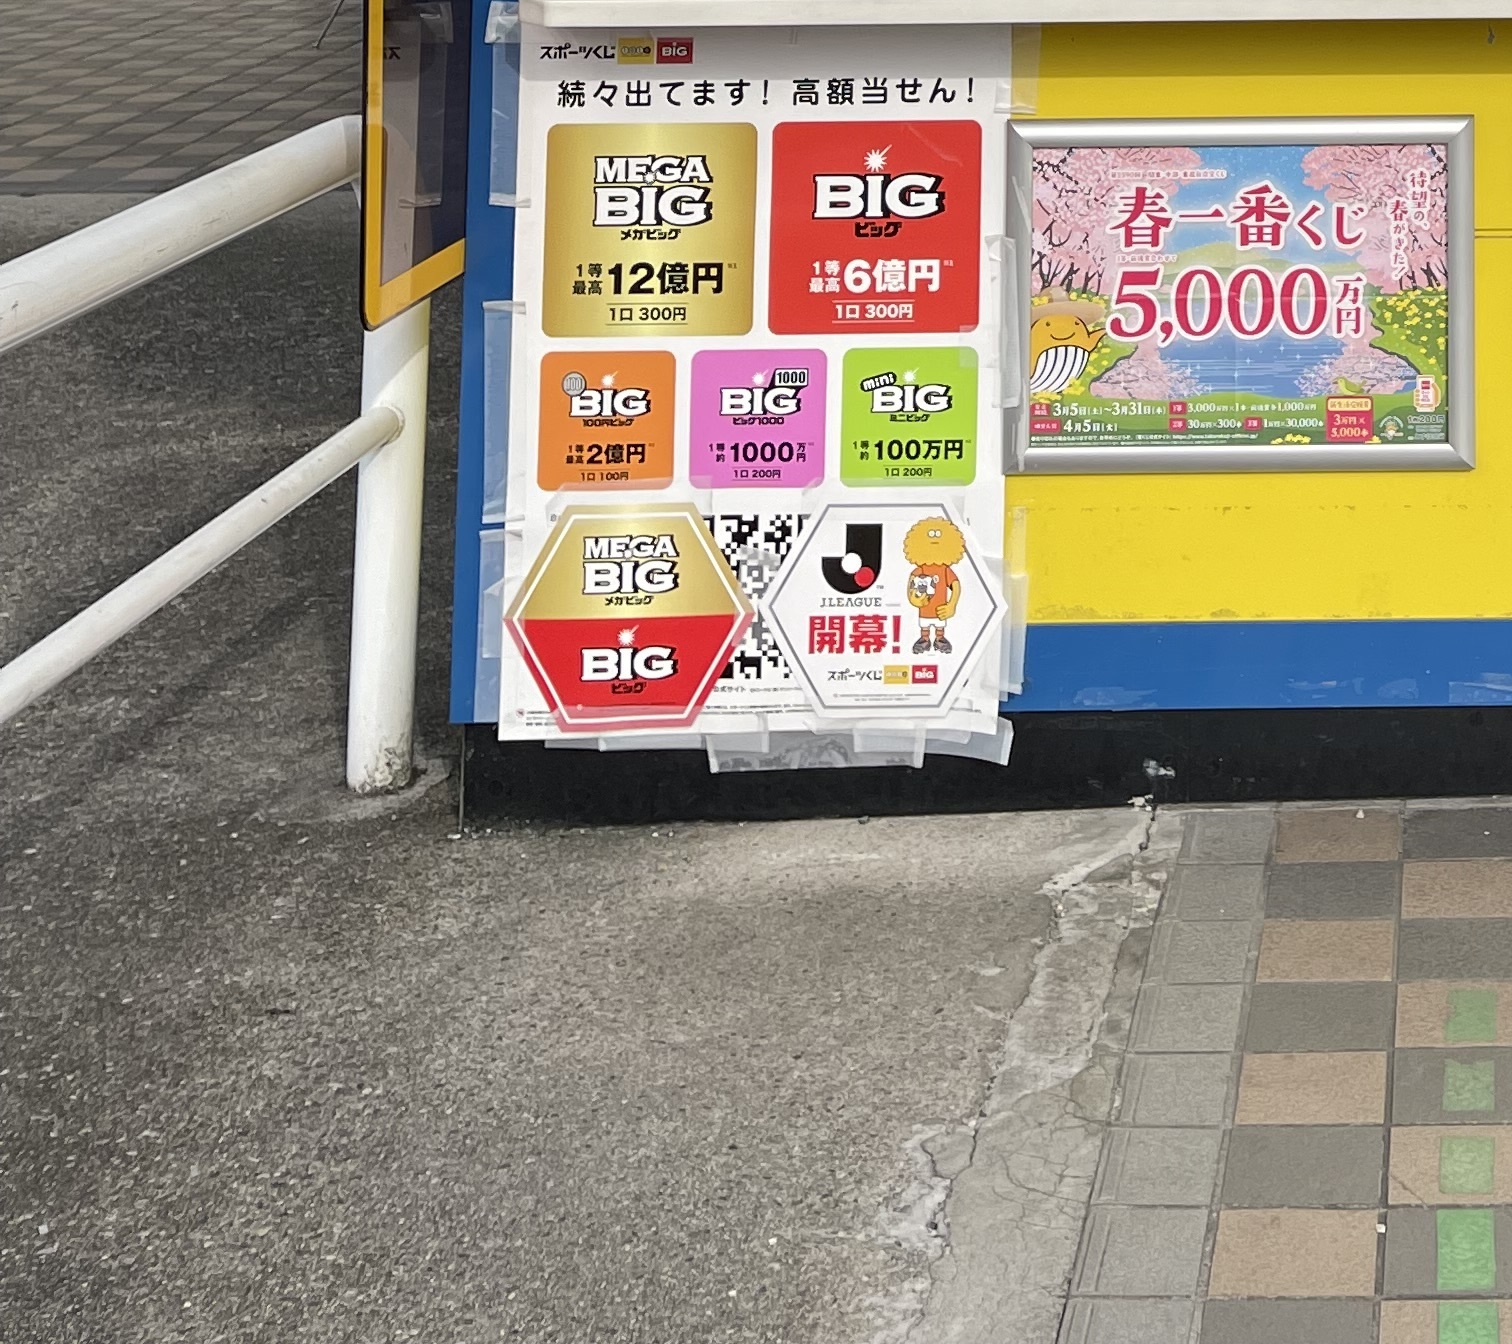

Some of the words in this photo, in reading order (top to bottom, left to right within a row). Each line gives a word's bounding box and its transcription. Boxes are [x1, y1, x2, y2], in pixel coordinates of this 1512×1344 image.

[540, 42, 615, 59] スポーツくじ
[661, 42, 688, 56] BIG
[557, 80, 770, 107] 続々出てます!
[792, 77, 975, 106] 高額当せん!
[594, 154, 712, 184] MEGA
[812, 173, 946, 219] BIG
[592, 186, 712, 228] BIG
[1110, 184, 1364, 249] 春一番くじ
[620, 229, 681, 241] メガビッグ
[854, 222, 901, 238] ビッグ
[575, 263, 602, 277] 1等
[607, 262, 724, 295] 12億円
[812, 260, 840, 276] 1等
[844, 259, 941, 294] 6億円
[572, 280, 602, 296] 最高
[809, 278, 840, 294] 最高
[609, 306, 633, 322] 1口
[639, 306, 687, 322] 300円
[835, 304, 860, 320] 1口
[865, 303, 914, 319] 300円
[1109, 267, 1329, 345] 5,000
[776, 370, 806, 385] 1000
[862, 373, 895, 391] mini
[569, 386, 651, 416] BIG
[720, 387, 801, 415] BIG
[870, 386, 953, 413] BIG
[587, 443, 647, 464] 2億円
[730, 441, 794, 463] 1000
[875, 439, 963, 460] 100万円
[581, 472, 595, 481] 1口
[600, 471, 629, 481] 100円
[734, 470, 748, 479] 1口
[752, 469, 781, 478] 200円
[885, 468, 900, 477] 1口
[904, 467, 932, 477] 200円
[583, 534, 678, 559] MEGA
[582, 559, 678, 596] BIG
[604, 595, 654, 606] メガビッグ
[808, 615, 901, 655] 開幕!
[580, 645, 679, 683] BIG
[828, 668, 882, 683] スポーツくじ
[915, 667, 936, 680] BIG
[611, 682, 646, 695] ビッグ
